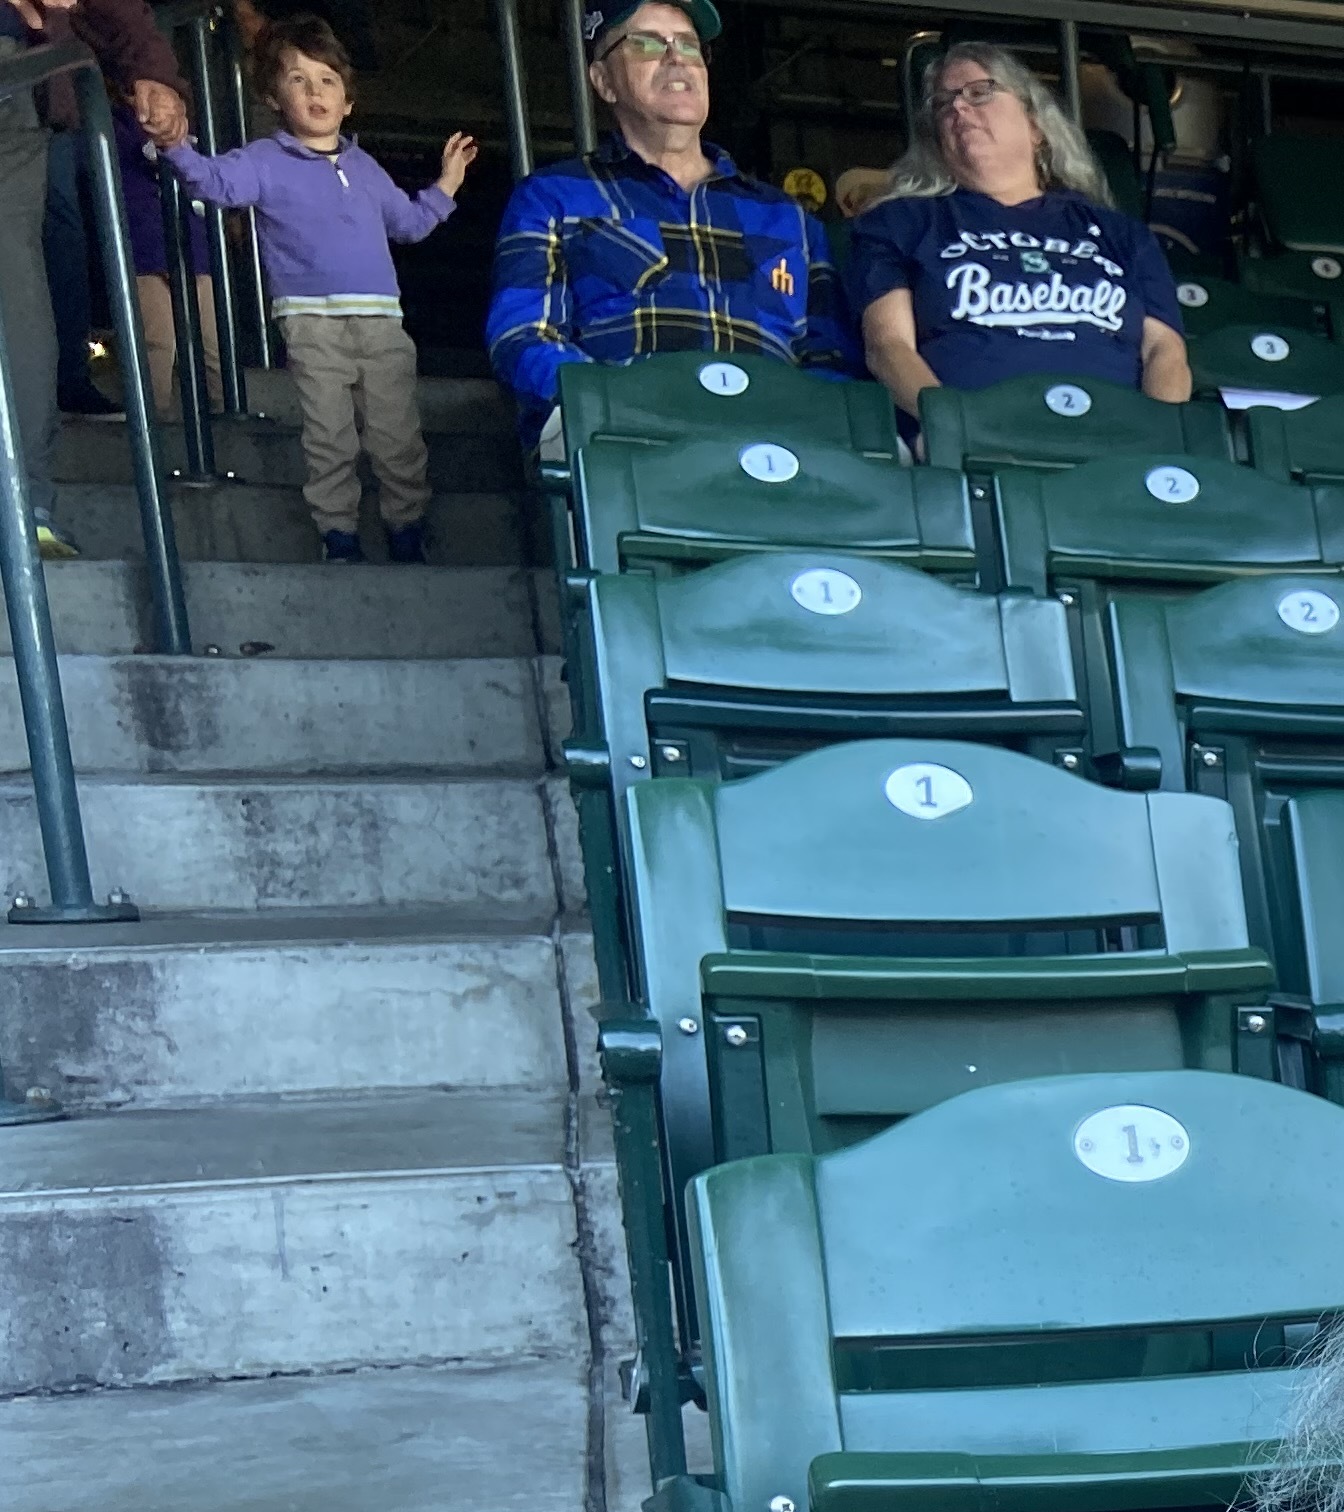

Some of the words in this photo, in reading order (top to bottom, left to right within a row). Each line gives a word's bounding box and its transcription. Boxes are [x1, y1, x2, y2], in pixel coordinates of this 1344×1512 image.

[946, 262, 1127, 322] Baseball
[720, 372, 727, 387] 1
[1062, 393, 1075, 409] 2
[1165, 476, 1180, 494] 2
[819, 581, 834, 603] 1
[1301, 602, 1318, 622] 2
[915, 776, 938, 808] 1
[1120, 1124, 1146, 1163] 1
